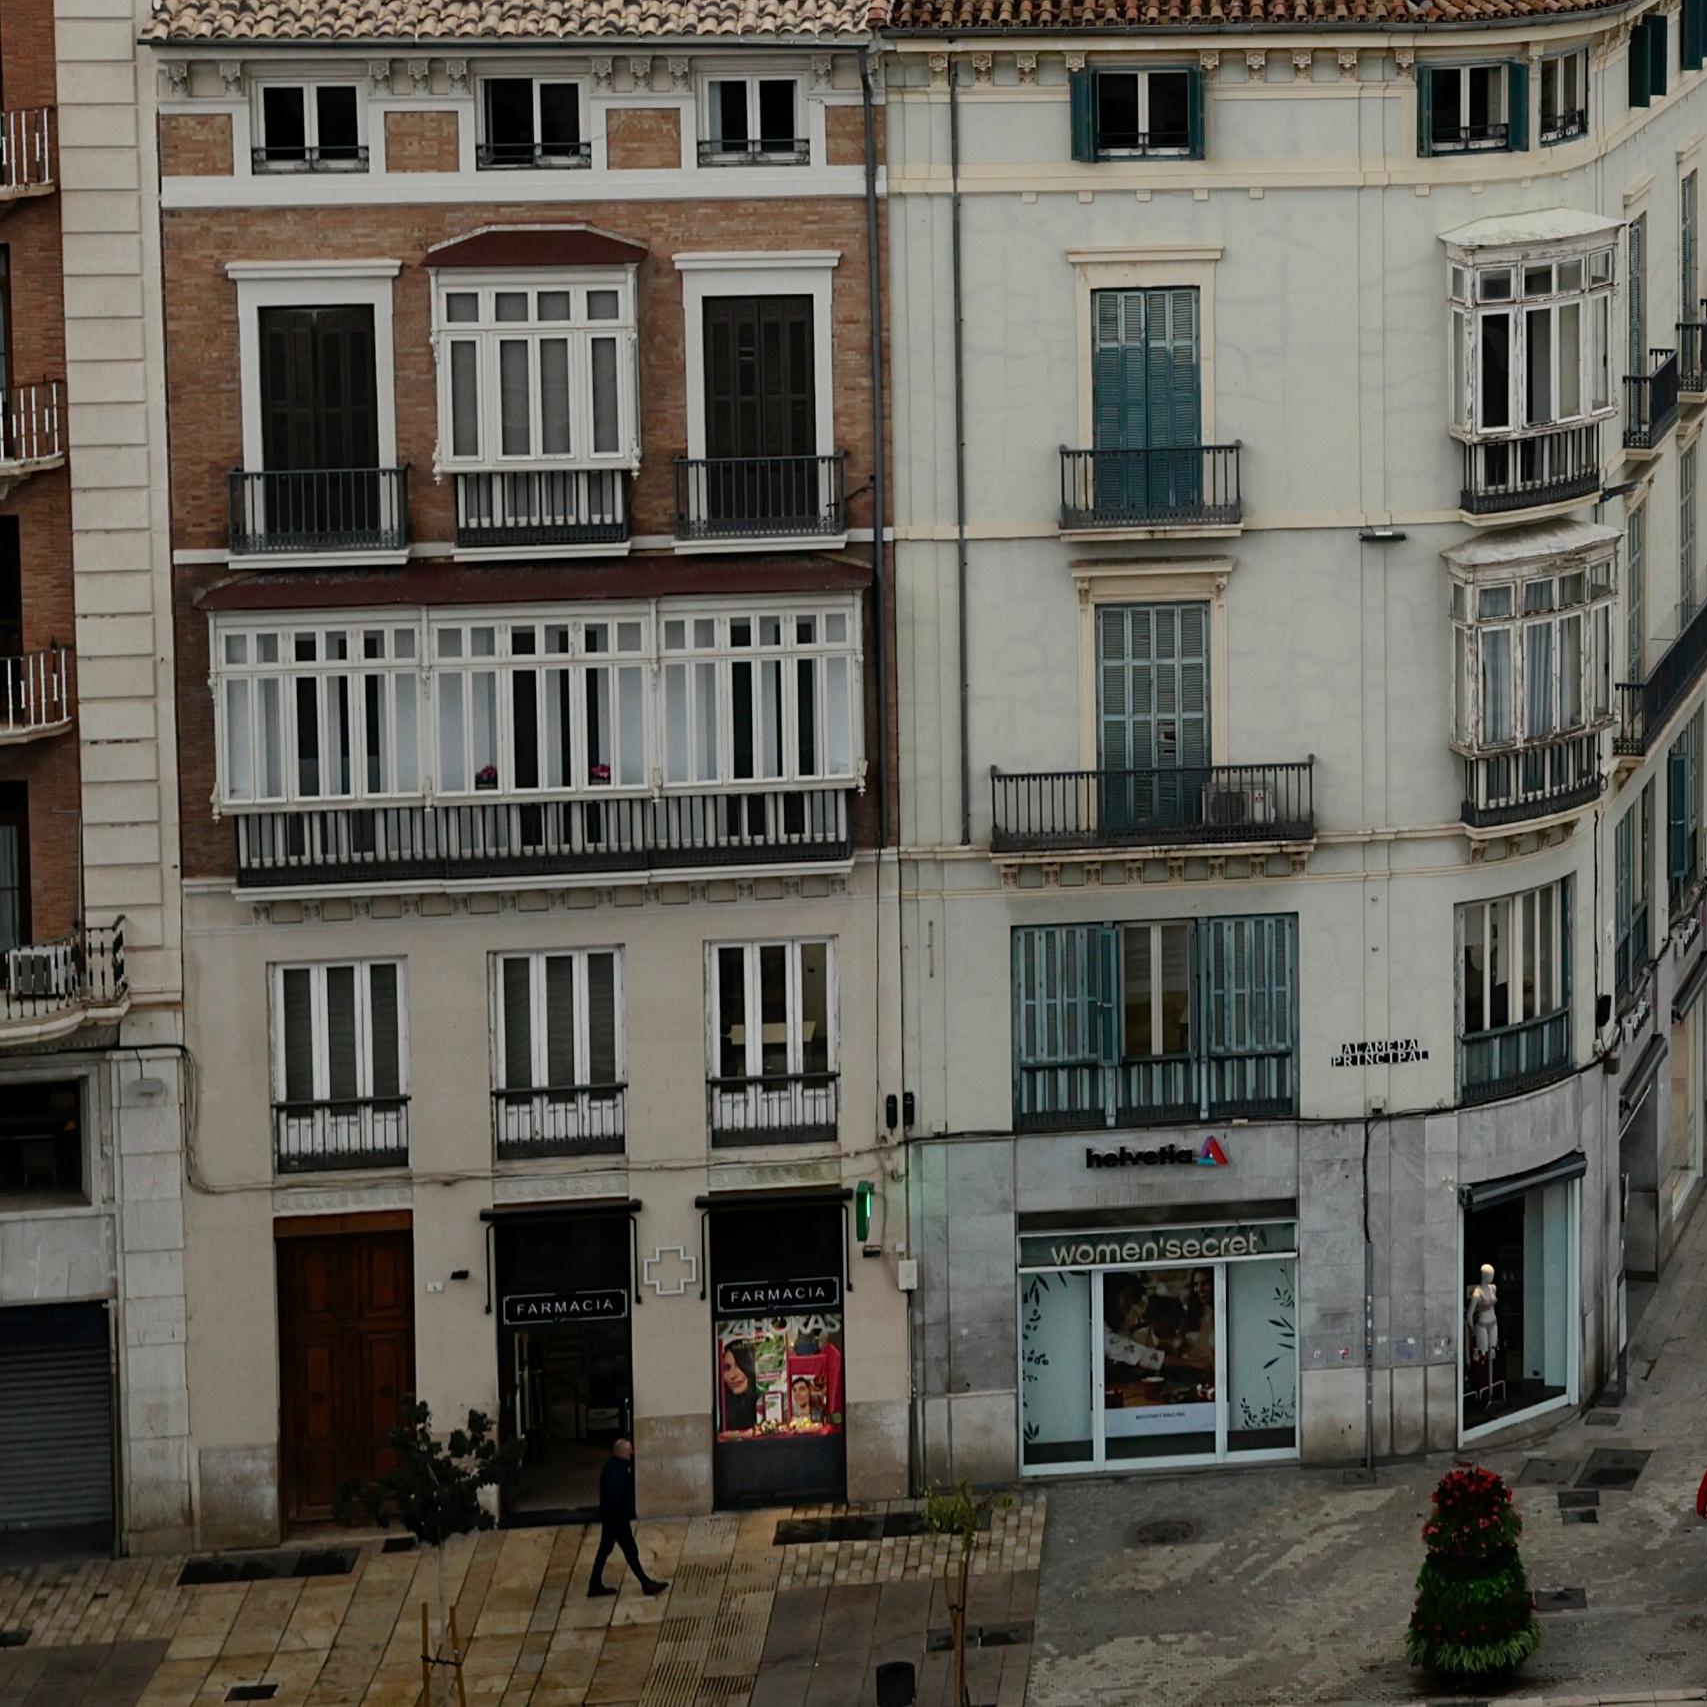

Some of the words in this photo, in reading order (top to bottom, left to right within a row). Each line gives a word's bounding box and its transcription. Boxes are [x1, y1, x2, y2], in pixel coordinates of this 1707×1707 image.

[1342, 1039, 1419, 1056] ALAMEDA
[1331, 1051, 1430, 1067] PRINCIPAL
[1086, 1144, 1193, 1169] helvetia
[1050, 1231, 1259, 1266] women'secret
[730, 1286, 826, 1303] FARMACIA
[516, 1298, 614, 1315] FARMACIA
